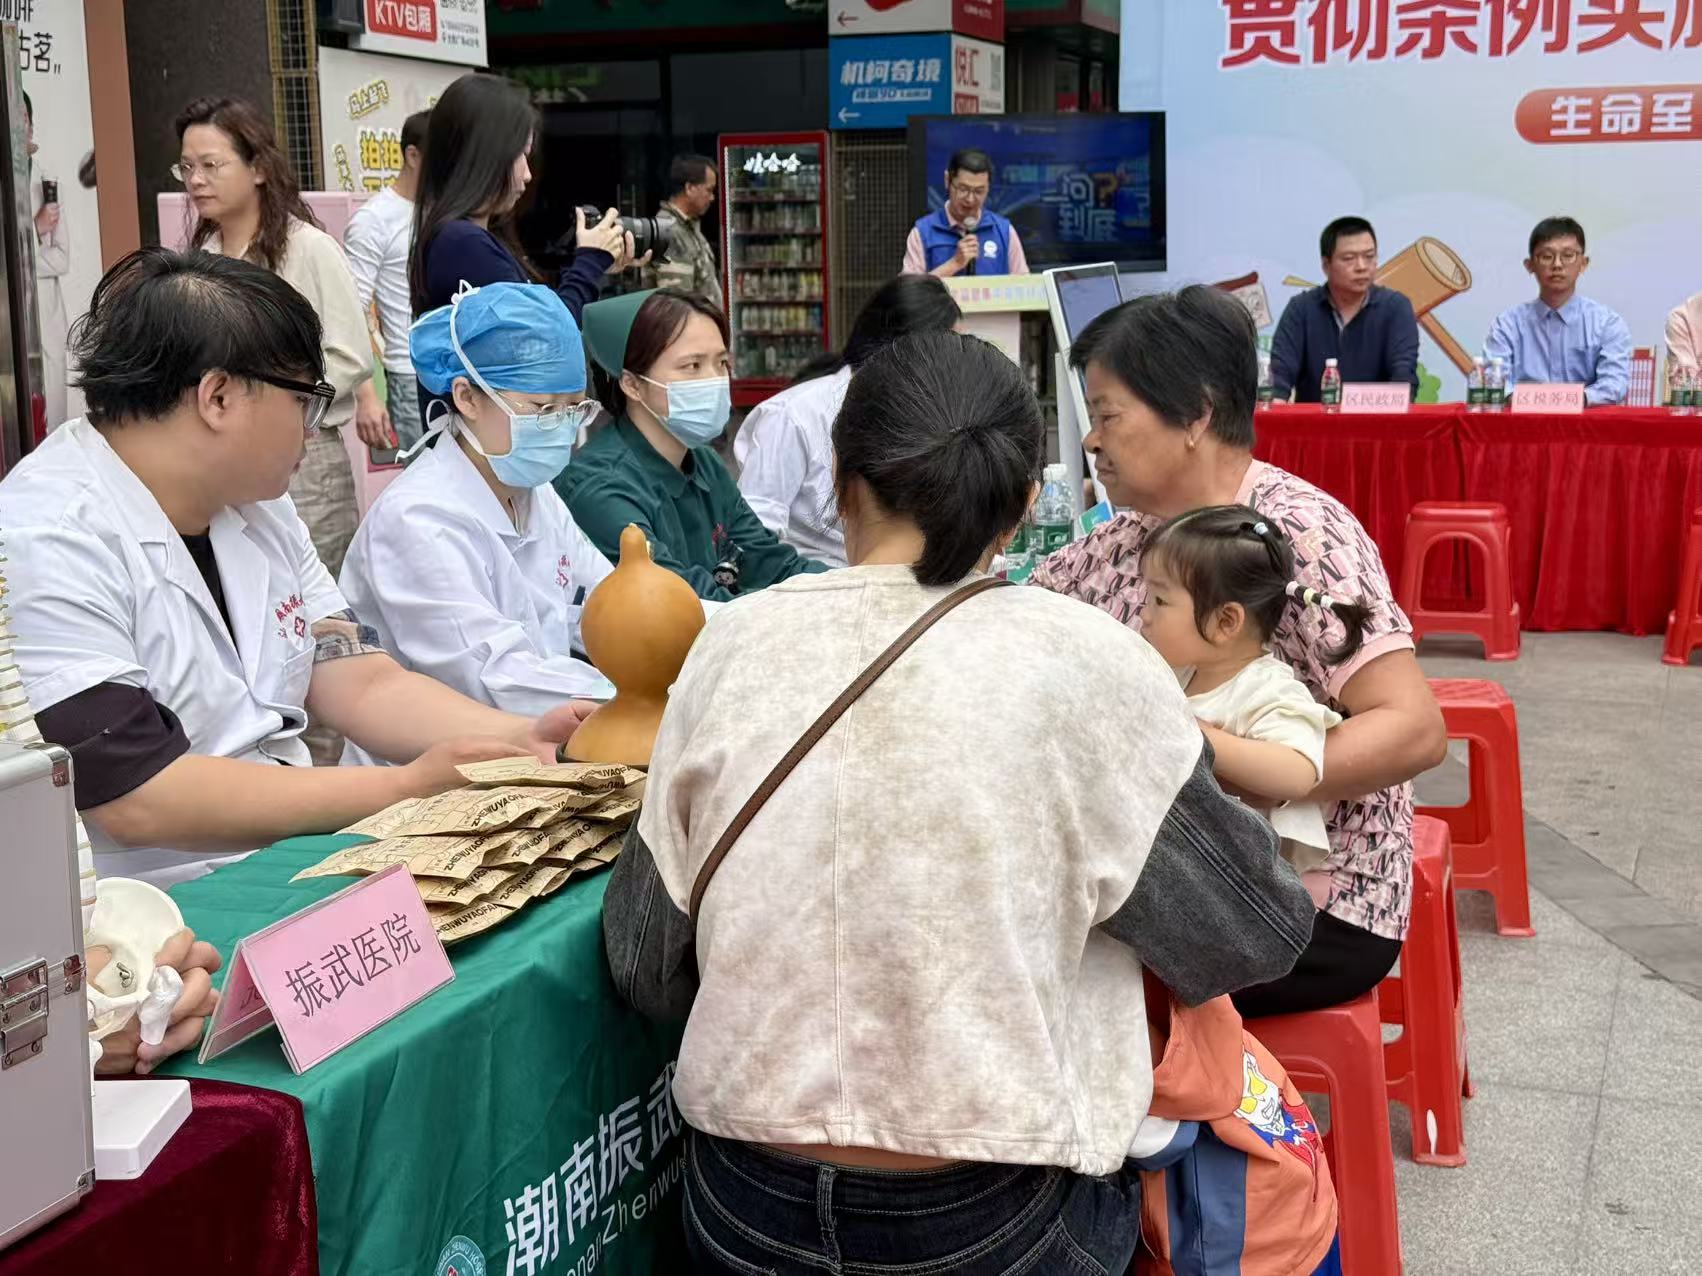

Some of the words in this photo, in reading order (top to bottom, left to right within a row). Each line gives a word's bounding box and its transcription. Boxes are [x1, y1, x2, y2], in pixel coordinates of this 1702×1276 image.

[1550, 91, 1694, 136] 生命至
[285, 912, 422, 1018] 振武医院
